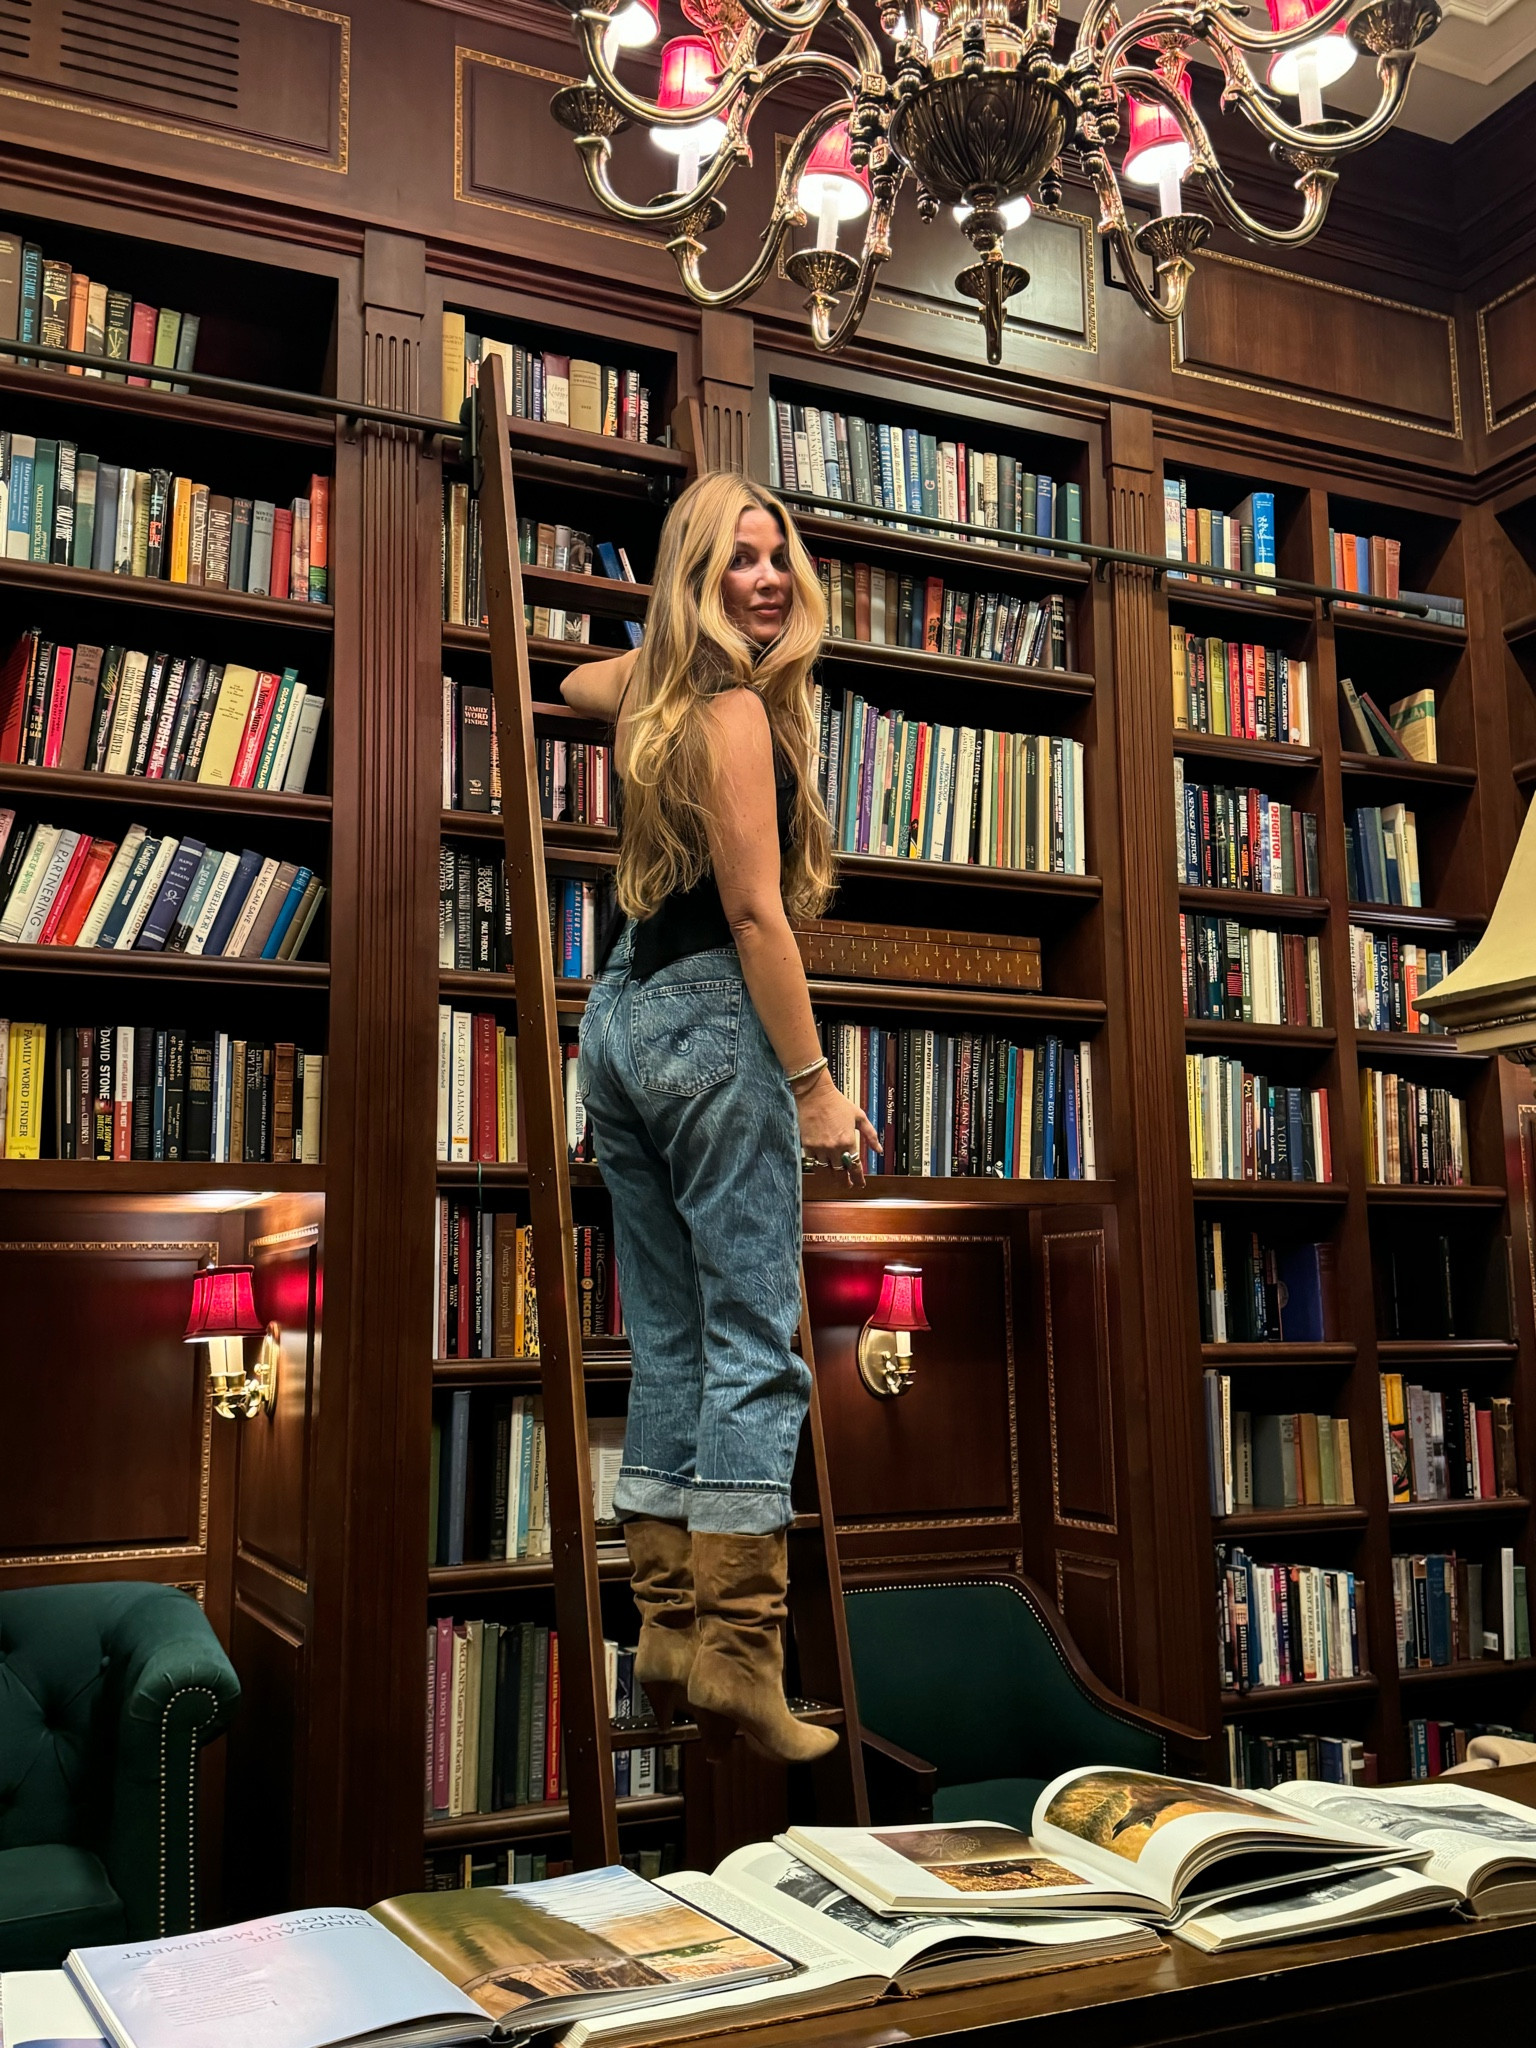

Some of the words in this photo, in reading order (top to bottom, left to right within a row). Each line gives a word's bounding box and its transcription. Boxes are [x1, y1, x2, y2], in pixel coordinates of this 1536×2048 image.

[515, 365, 523, 389] APPEAL
[628, 372, 638, 391] BRAD
[515, 394, 523, 413] JOHN
[628, 392, 637, 418] TAYLOR
[24, 463, 32, 495] Harpoon
[56, 506, 74, 525] COLD
[37, 648, 50, 677] THOMAS
[35, 677, 46, 701] PERRY
[161, 673, 184, 716] HARLAN
[276, 686, 290, 714] COLOURS
[117, 692, 131, 717] FLOWS
[464, 705, 488, 713] FAMILY
[464, 711, 488, 720] WORD
[114, 718, 126, 734] THE
[271, 722, 281, 735] THE
[274, 713, 283, 723] OF
[464, 718, 488, 726] FINDER
[154, 714, 174, 749] COBEN
[266, 734, 278, 752] ARAB
[829, 715, 840, 760] MAXFIELD
[110, 734, 123, 755] RIVER
[904, 763, 913, 800] GARDENS
[1189, 819, 1196, 831] OF
[1270, 805, 1282, 859] DEIGHTON
[1190, 832, 1198, 866] HISTORY
[197, 869, 210, 887] DEAD
[216, 870, 231, 891] BIRD
[263, 861, 275, 876] ALL
[477, 868, 486, 877] OF
[29, 848, 70, 929] PARTNERING
[146, 882, 158, 901] ONE
[259, 876, 269, 888] WE
[477, 878, 486, 907] OCEANIA
[484, 877, 493, 897] HAPPY
[251, 888, 264, 906] CAN
[131, 902, 150, 936] NATION
[200, 890, 223, 931] BEHAVIOR
[243, 905, 257, 924] SAVE
[458, 912, 470, 948] INNOCENT
[1380, 950, 1387, 963] LA
[1380, 965, 1390, 993] BALSA
[24, 1029, 32, 1064] FAMILY
[100, 1030, 110, 1061] DAVID
[458, 1021, 466, 1054] PLACES
[914, 1055, 922, 1074] LAST
[22, 1067, 31, 1097] WORD
[99, 1065, 110, 1099] STONE
[914, 1077, 922, 1097] TWO
[962, 1062, 971, 1125] AUSTRALIAN
[19, 1101, 30, 1137] FINDER
[457, 1088, 465, 1134] ALMANAC
[961, 1128, 970, 1155] YEAR
[1277, 1125, 1287, 1162] YORK
[583, 1292, 591, 1316] INCA
[1279, 1568, 1287, 1599] LAWRENCE
[456, 1720, 464, 1736] Fish
[456, 1737, 464, 1748] of
[454, 1750, 463, 1773] North
[253, 1920, 373, 1943] DINOSAUR
[260, 1914, 366, 1932] NATIONAL
[122, 1931, 254, 1960] MONUMENT
